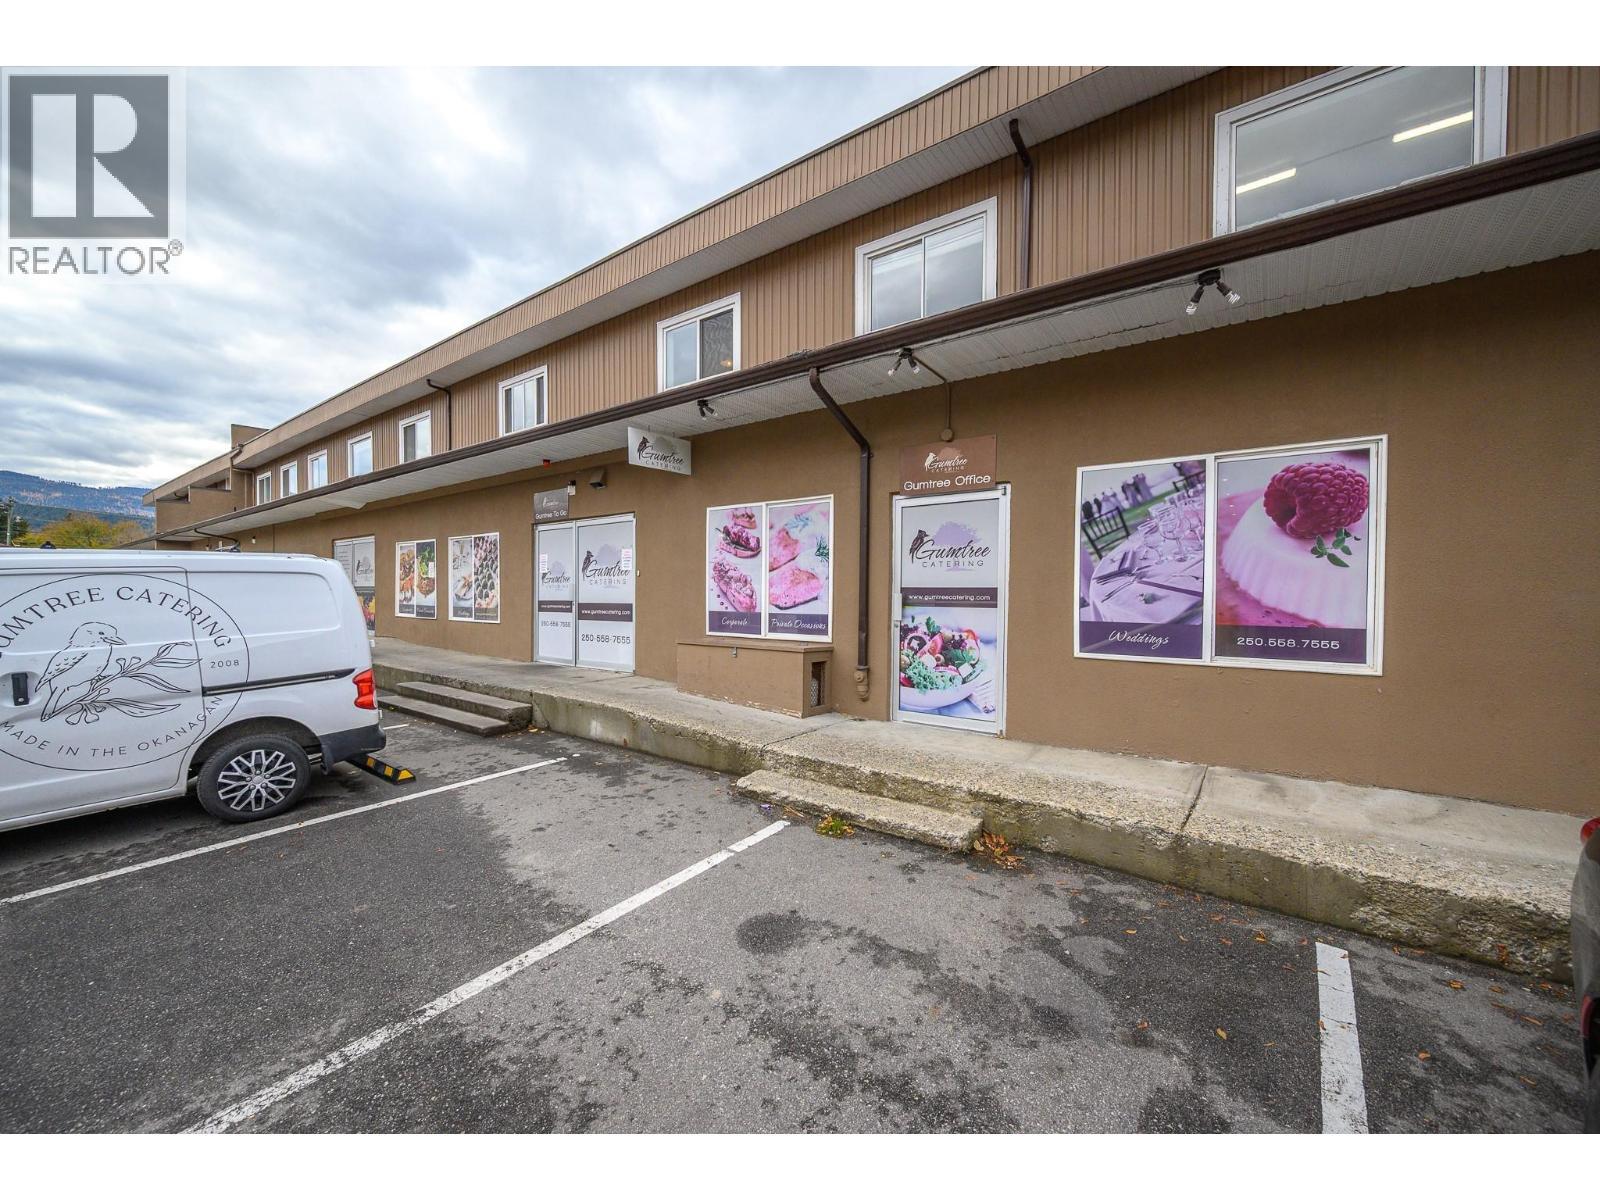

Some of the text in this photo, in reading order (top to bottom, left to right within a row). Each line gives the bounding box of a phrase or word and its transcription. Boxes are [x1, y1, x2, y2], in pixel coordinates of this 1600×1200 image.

[641, 445, 684, 465] Gumtree
[928, 456, 968, 469] Gumtree
[903, 474, 992, 491] Gumtree Office
[915, 539, 992, 560] Gumtree
[585, 559, 630, 578] Gumtree
[922, 560, 984, 568] CATERING
[589, 578, 627, 586] CATERING
[908, 594, 991, 602] www.gumtreecatering.com
[116, 586, 232, 648] CATERING
[721, 616, 749, 628] Corporate
[771, 618, 793, 628] Private
[581, 633, 631, 645] 250-558-7555
[1108, 629, 1170, 650] Weddings
[1236, 637, 1341, 650] 250.558.7555
[210, 659, 240, 669] 2008
[0, 696, 224, 757] MADE IN THE OKANAGAN
